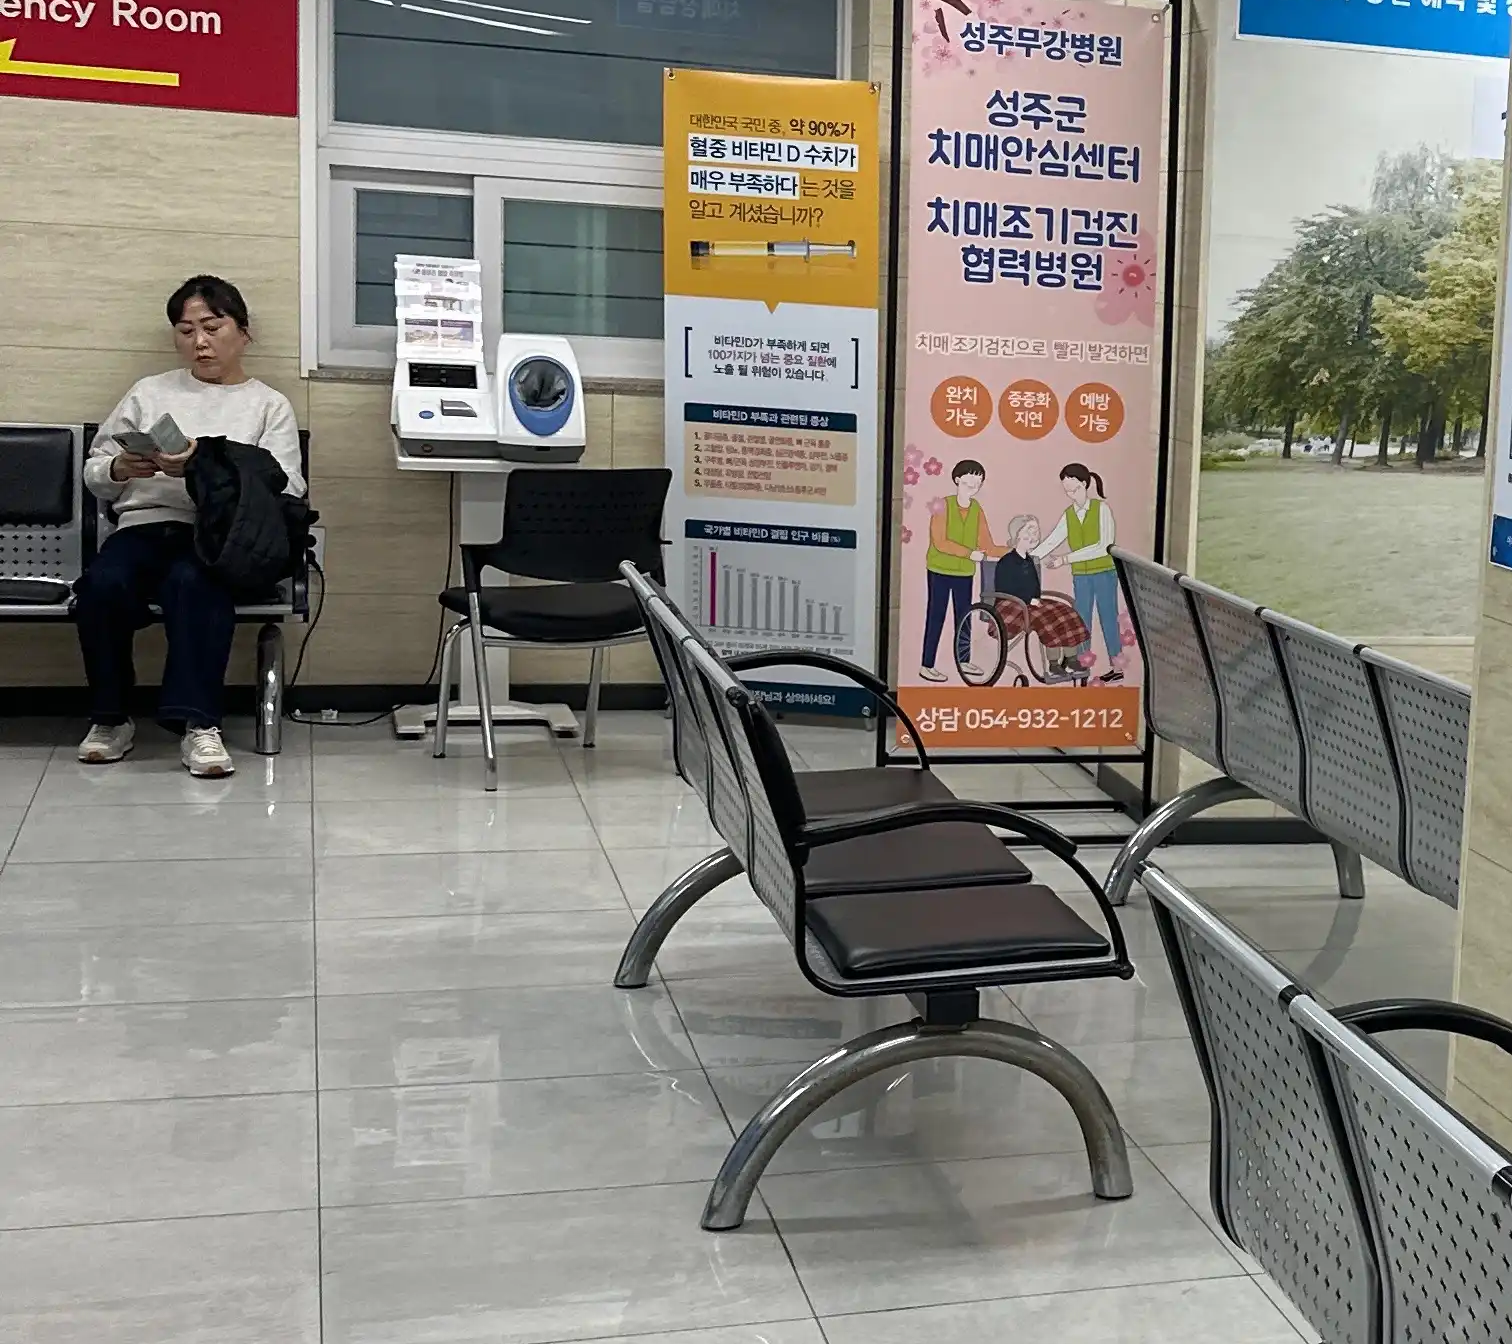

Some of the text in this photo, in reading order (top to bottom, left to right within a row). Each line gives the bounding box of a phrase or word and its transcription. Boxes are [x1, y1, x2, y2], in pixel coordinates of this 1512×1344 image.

[959, 21, 1122, 67] 성주무강병원
[986, 89, 1087, 133] 성주군
[689, 114, 738, 132] 대한민국
[740, 117, 767, 133] 국민
[789, 119, 804, 135] 약
[808, 121, 856, 139] 90%가
[690, 136, 856, 168] 혈중 비타민 D 수치가
[927, 128, 1141, 183] 치매안심센터
[690, 171, 726, 191] 매우
[821, 179, 856, 200] 것을
[689, 200, 824, 229] 알고 계셨습니까?
[927, 196, 1138, 249] 치매조기검진
[960, 243, 1103, 291] 협력병원
[708, 349, 757, 362] 100가지가
[714, 335, 763, 349] 비타민D가
[766, 338, 807, 352] 부족하게
[916, 332, 1149, 364] 치매 조기검진으로 빨리 발견하면
[945, 385, 979, 405] 완치
[1079, 393, 1110, 411] 예방
[713, 409, 747, 422] 비타민D
[945, 408, 978, 428] 가능
[1014, 411, 1043, 428] 지연
[1078, 413, 1111, 433] 가능
[750, 688, 782, 703] 장님과
[915, 707, 1124, 735] 상담 054-932-1212
